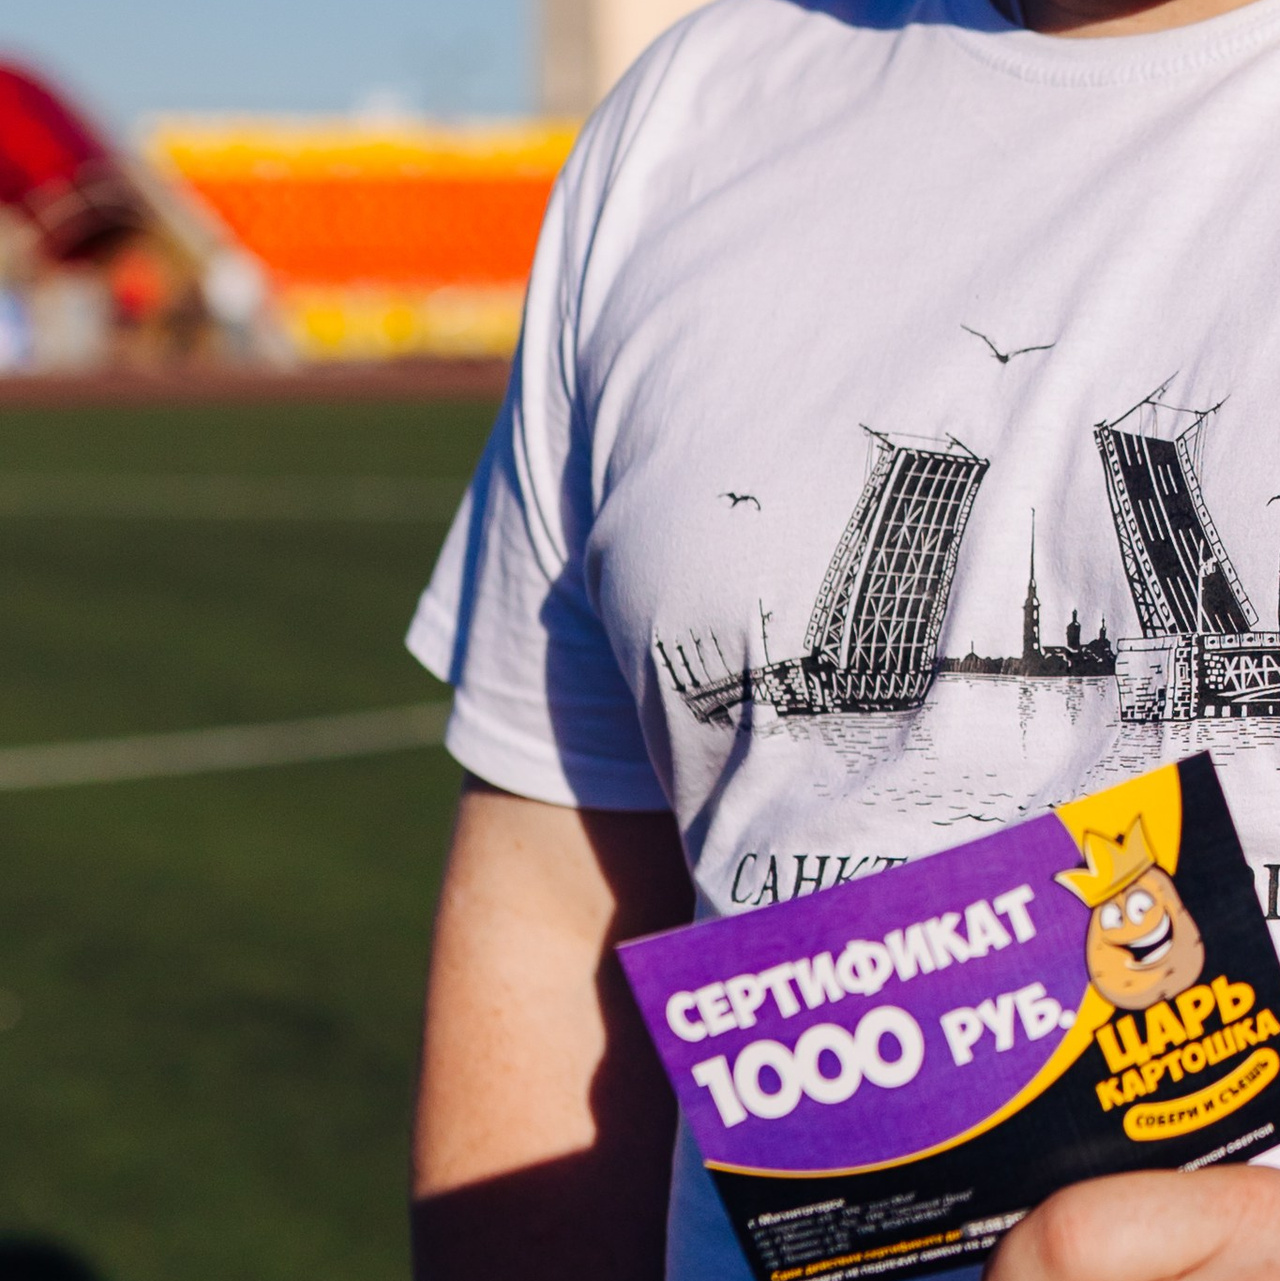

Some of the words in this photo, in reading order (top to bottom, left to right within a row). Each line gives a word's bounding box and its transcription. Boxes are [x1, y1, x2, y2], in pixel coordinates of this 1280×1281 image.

[731, 852, 909, 905] САНК
[665, 883, 1037, 1042] СЕРТИФИКАТ
[691, 1005, 925, 1128] 1000
[940, 981, 1077, 1066] РУБ.
[1096, 975, 1256, 1074] ЦАРЬ
